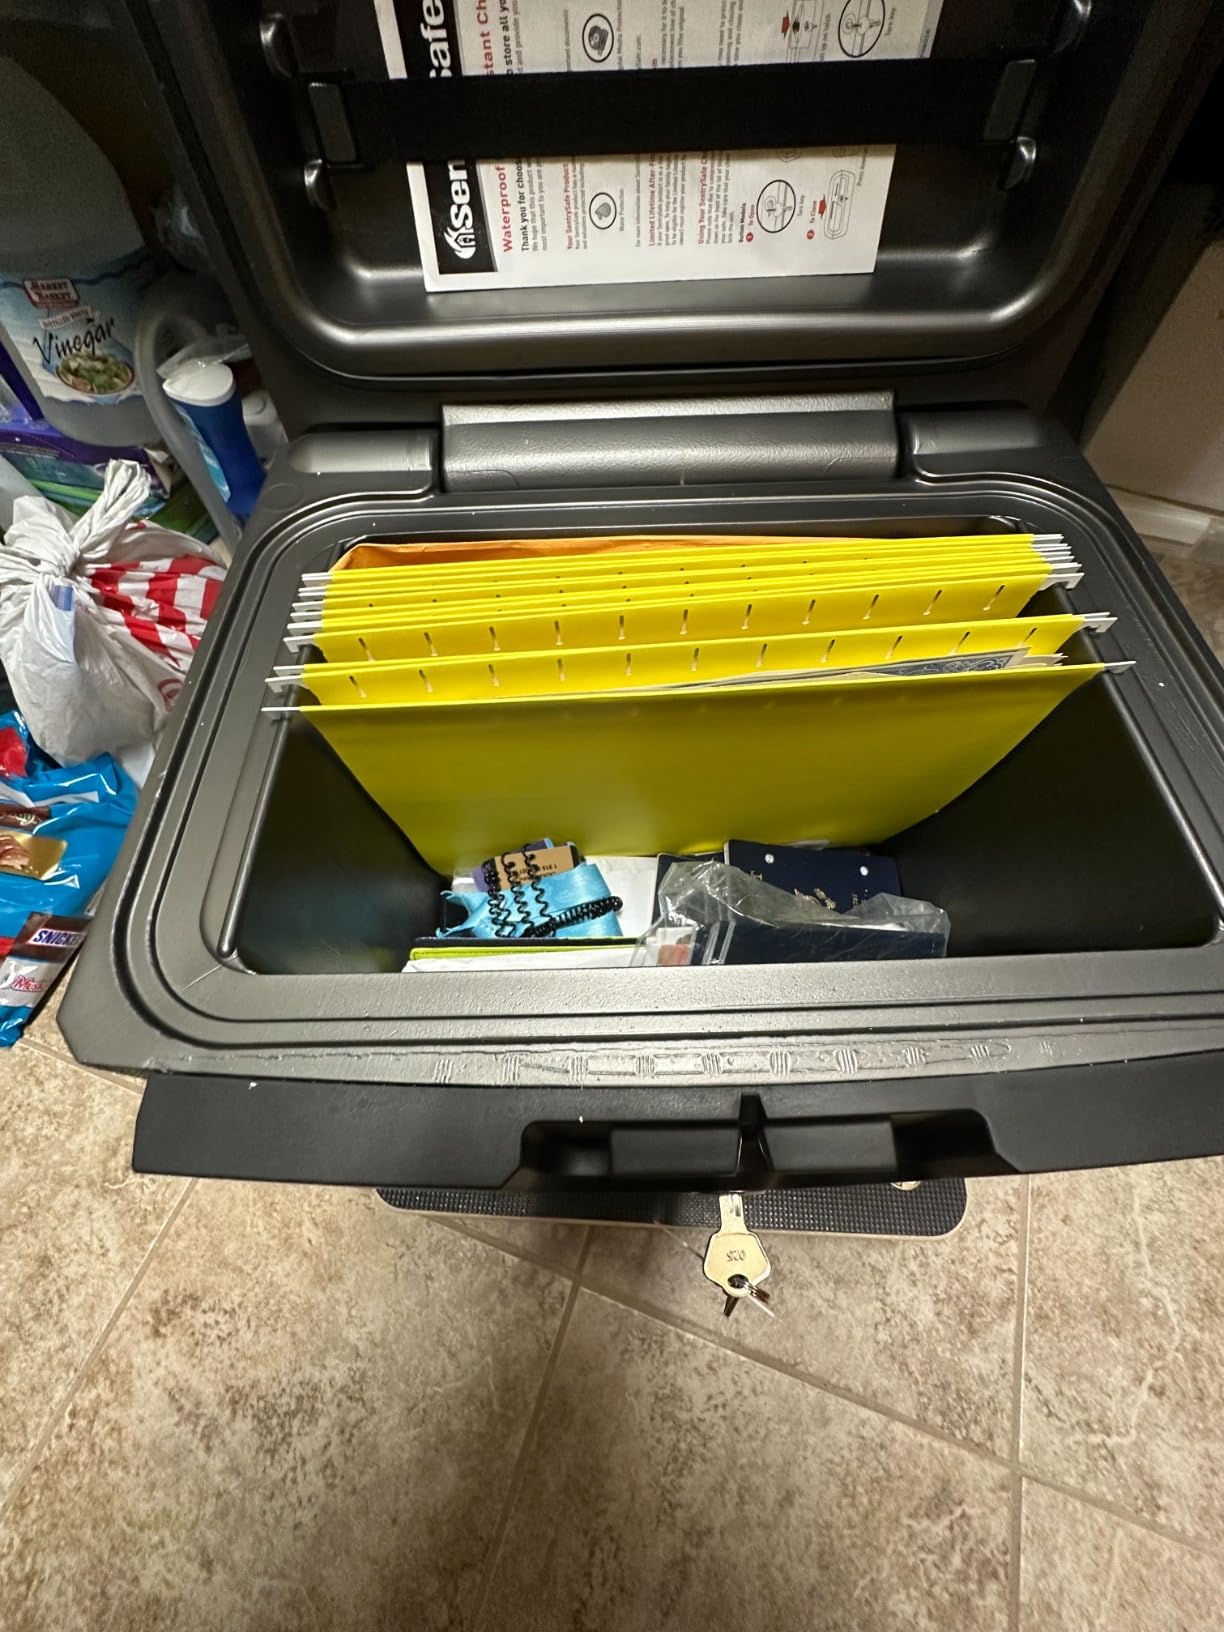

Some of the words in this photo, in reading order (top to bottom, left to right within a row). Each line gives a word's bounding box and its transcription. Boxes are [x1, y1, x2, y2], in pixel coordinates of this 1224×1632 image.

[499, 16, 509, 32] all
[503, 35, 512, 65] store
[517, 191, 525, 204] for
[699, 167, 707, 206] SentrySafe
[496, 166, 512, 252] Waterproof
[520, 207, 528, 223] you
[520, 226, 529, 251] Thank
[698, 225, 706, 244] Using
[33, 317, 114, 364] Vinegar
